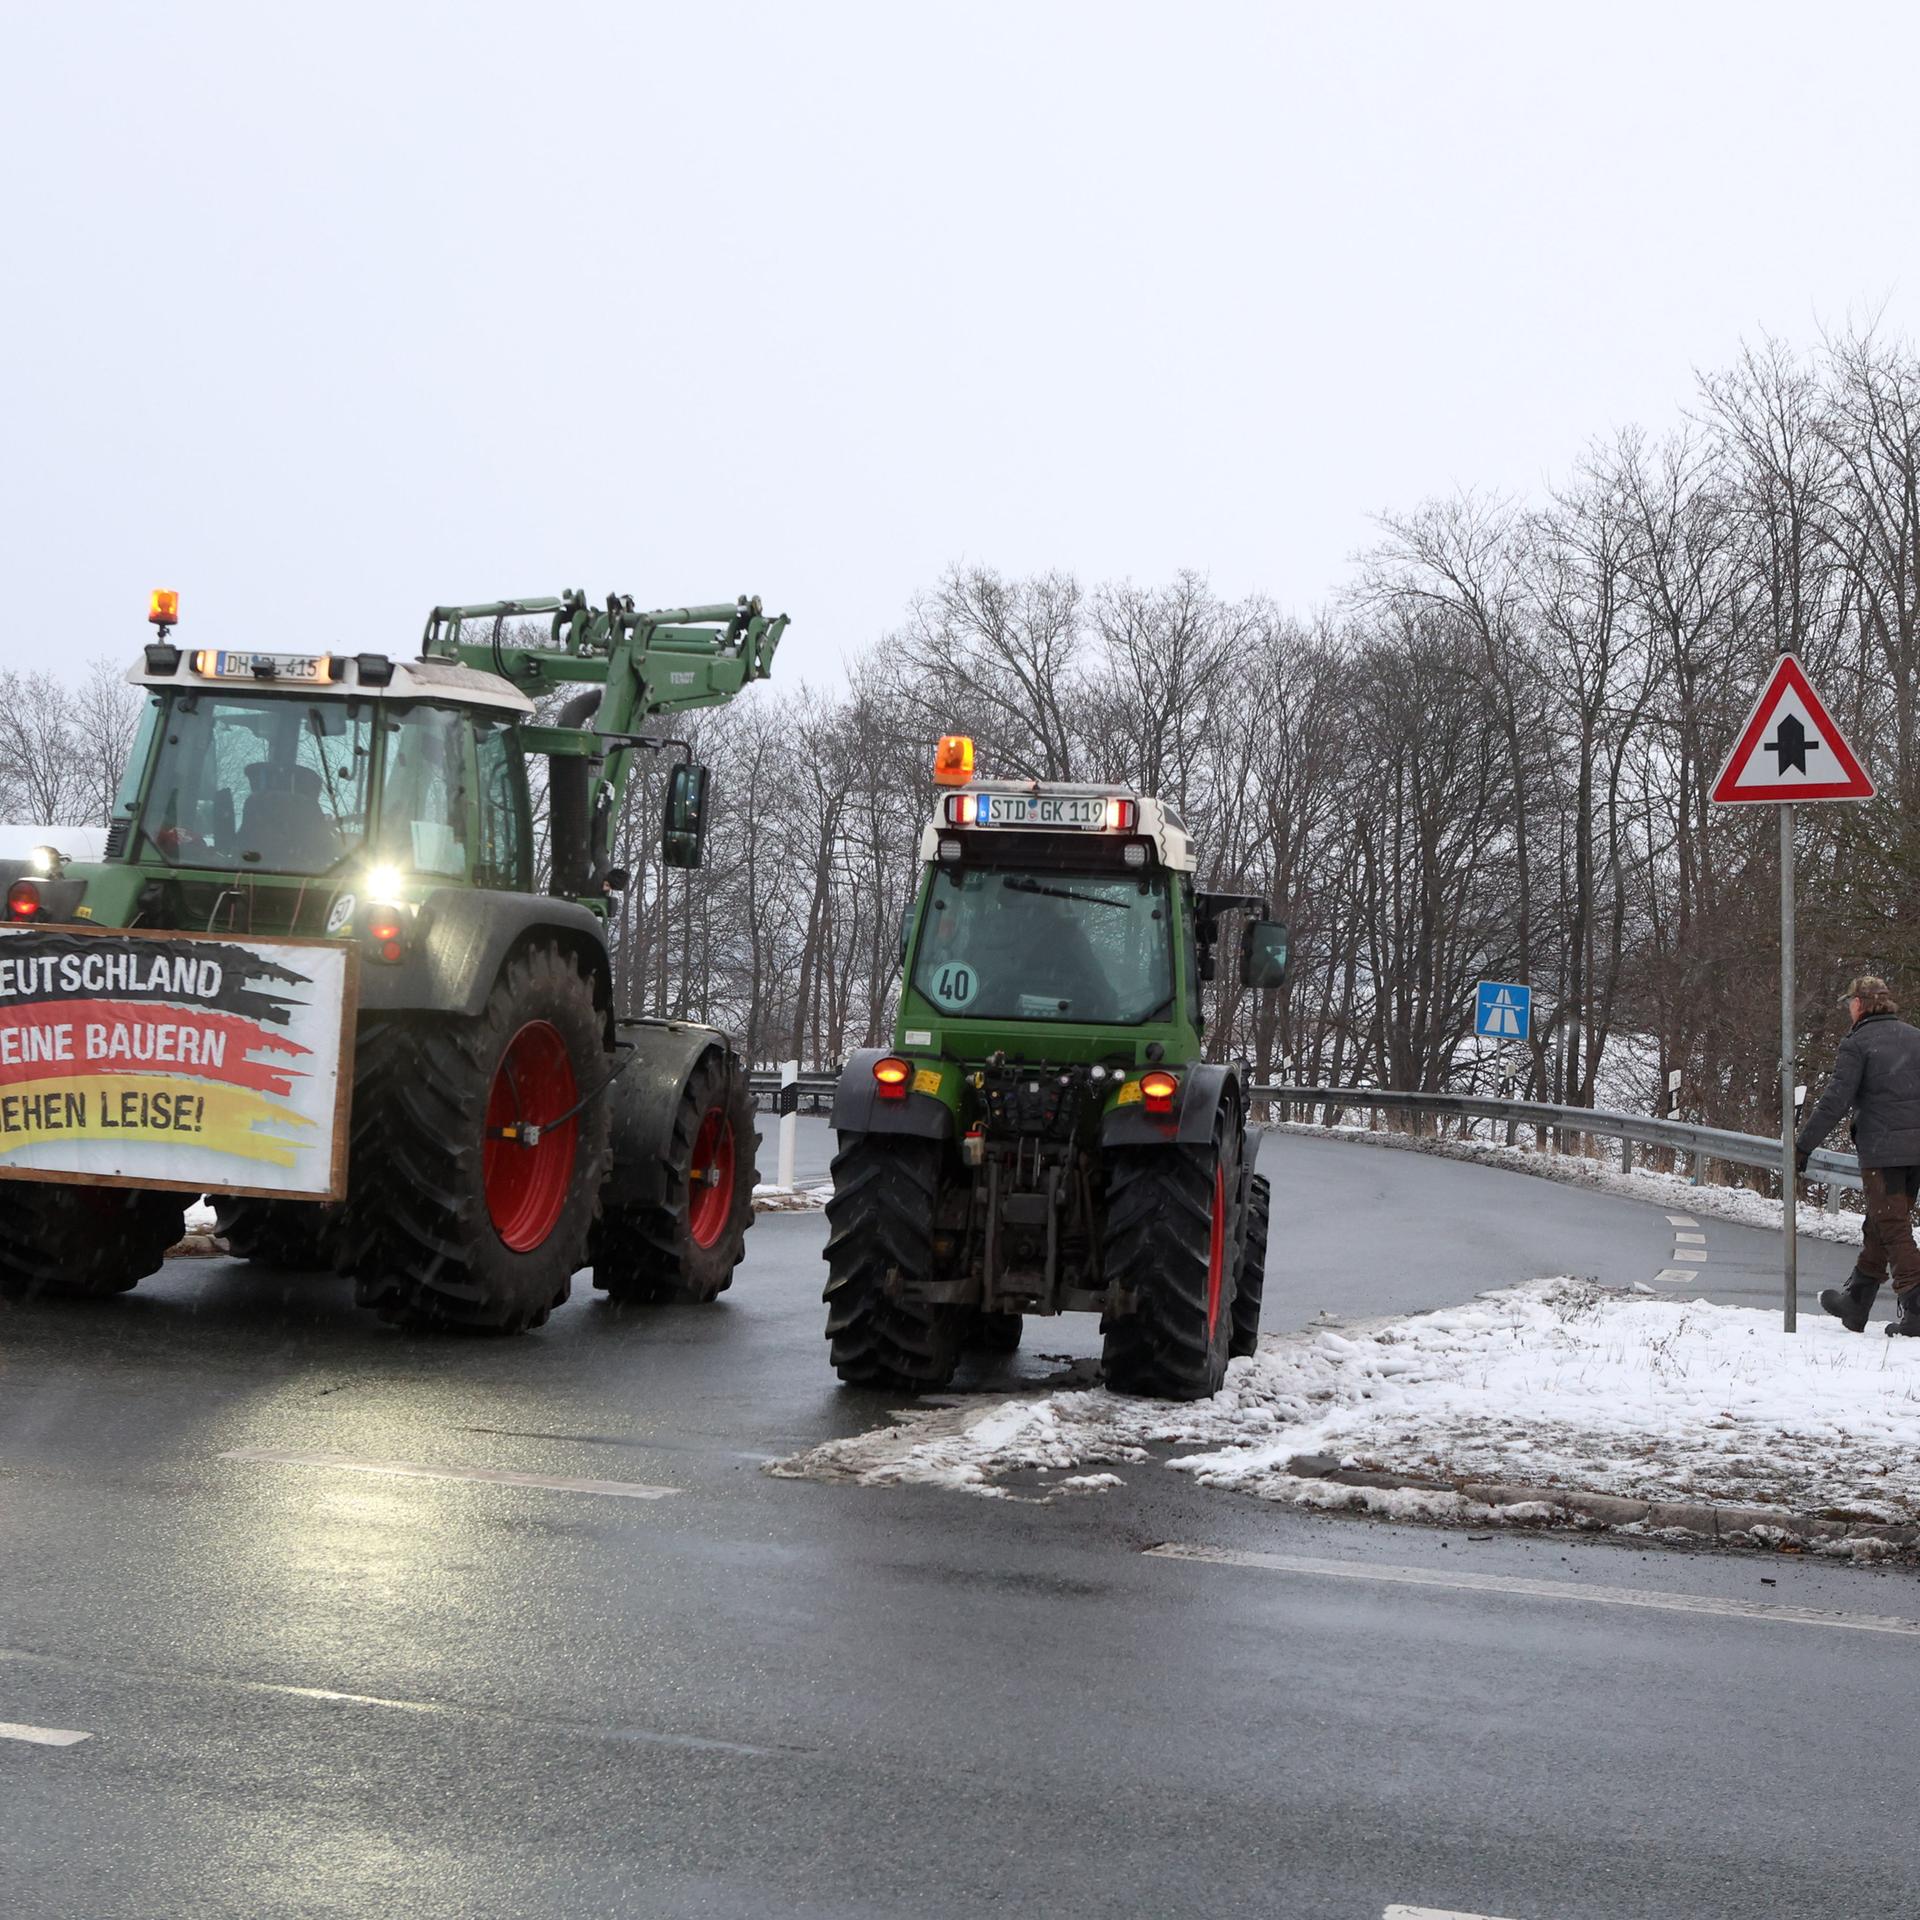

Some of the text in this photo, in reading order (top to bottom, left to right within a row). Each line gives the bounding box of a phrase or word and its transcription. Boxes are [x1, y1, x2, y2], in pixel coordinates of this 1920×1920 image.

[226, 655, 249, 674] DH
[286, 658, 317, 677] 415
[991, 799, 1103, 823] STD GK 119
[0, 954, 223, 998] EUTSCHLAND
[939, 969, 969, 1001] 40
[2, 1023, 226, 1067] EINE BAUERN
[0, 1091, 205, 1132] EHEN LEISE!
